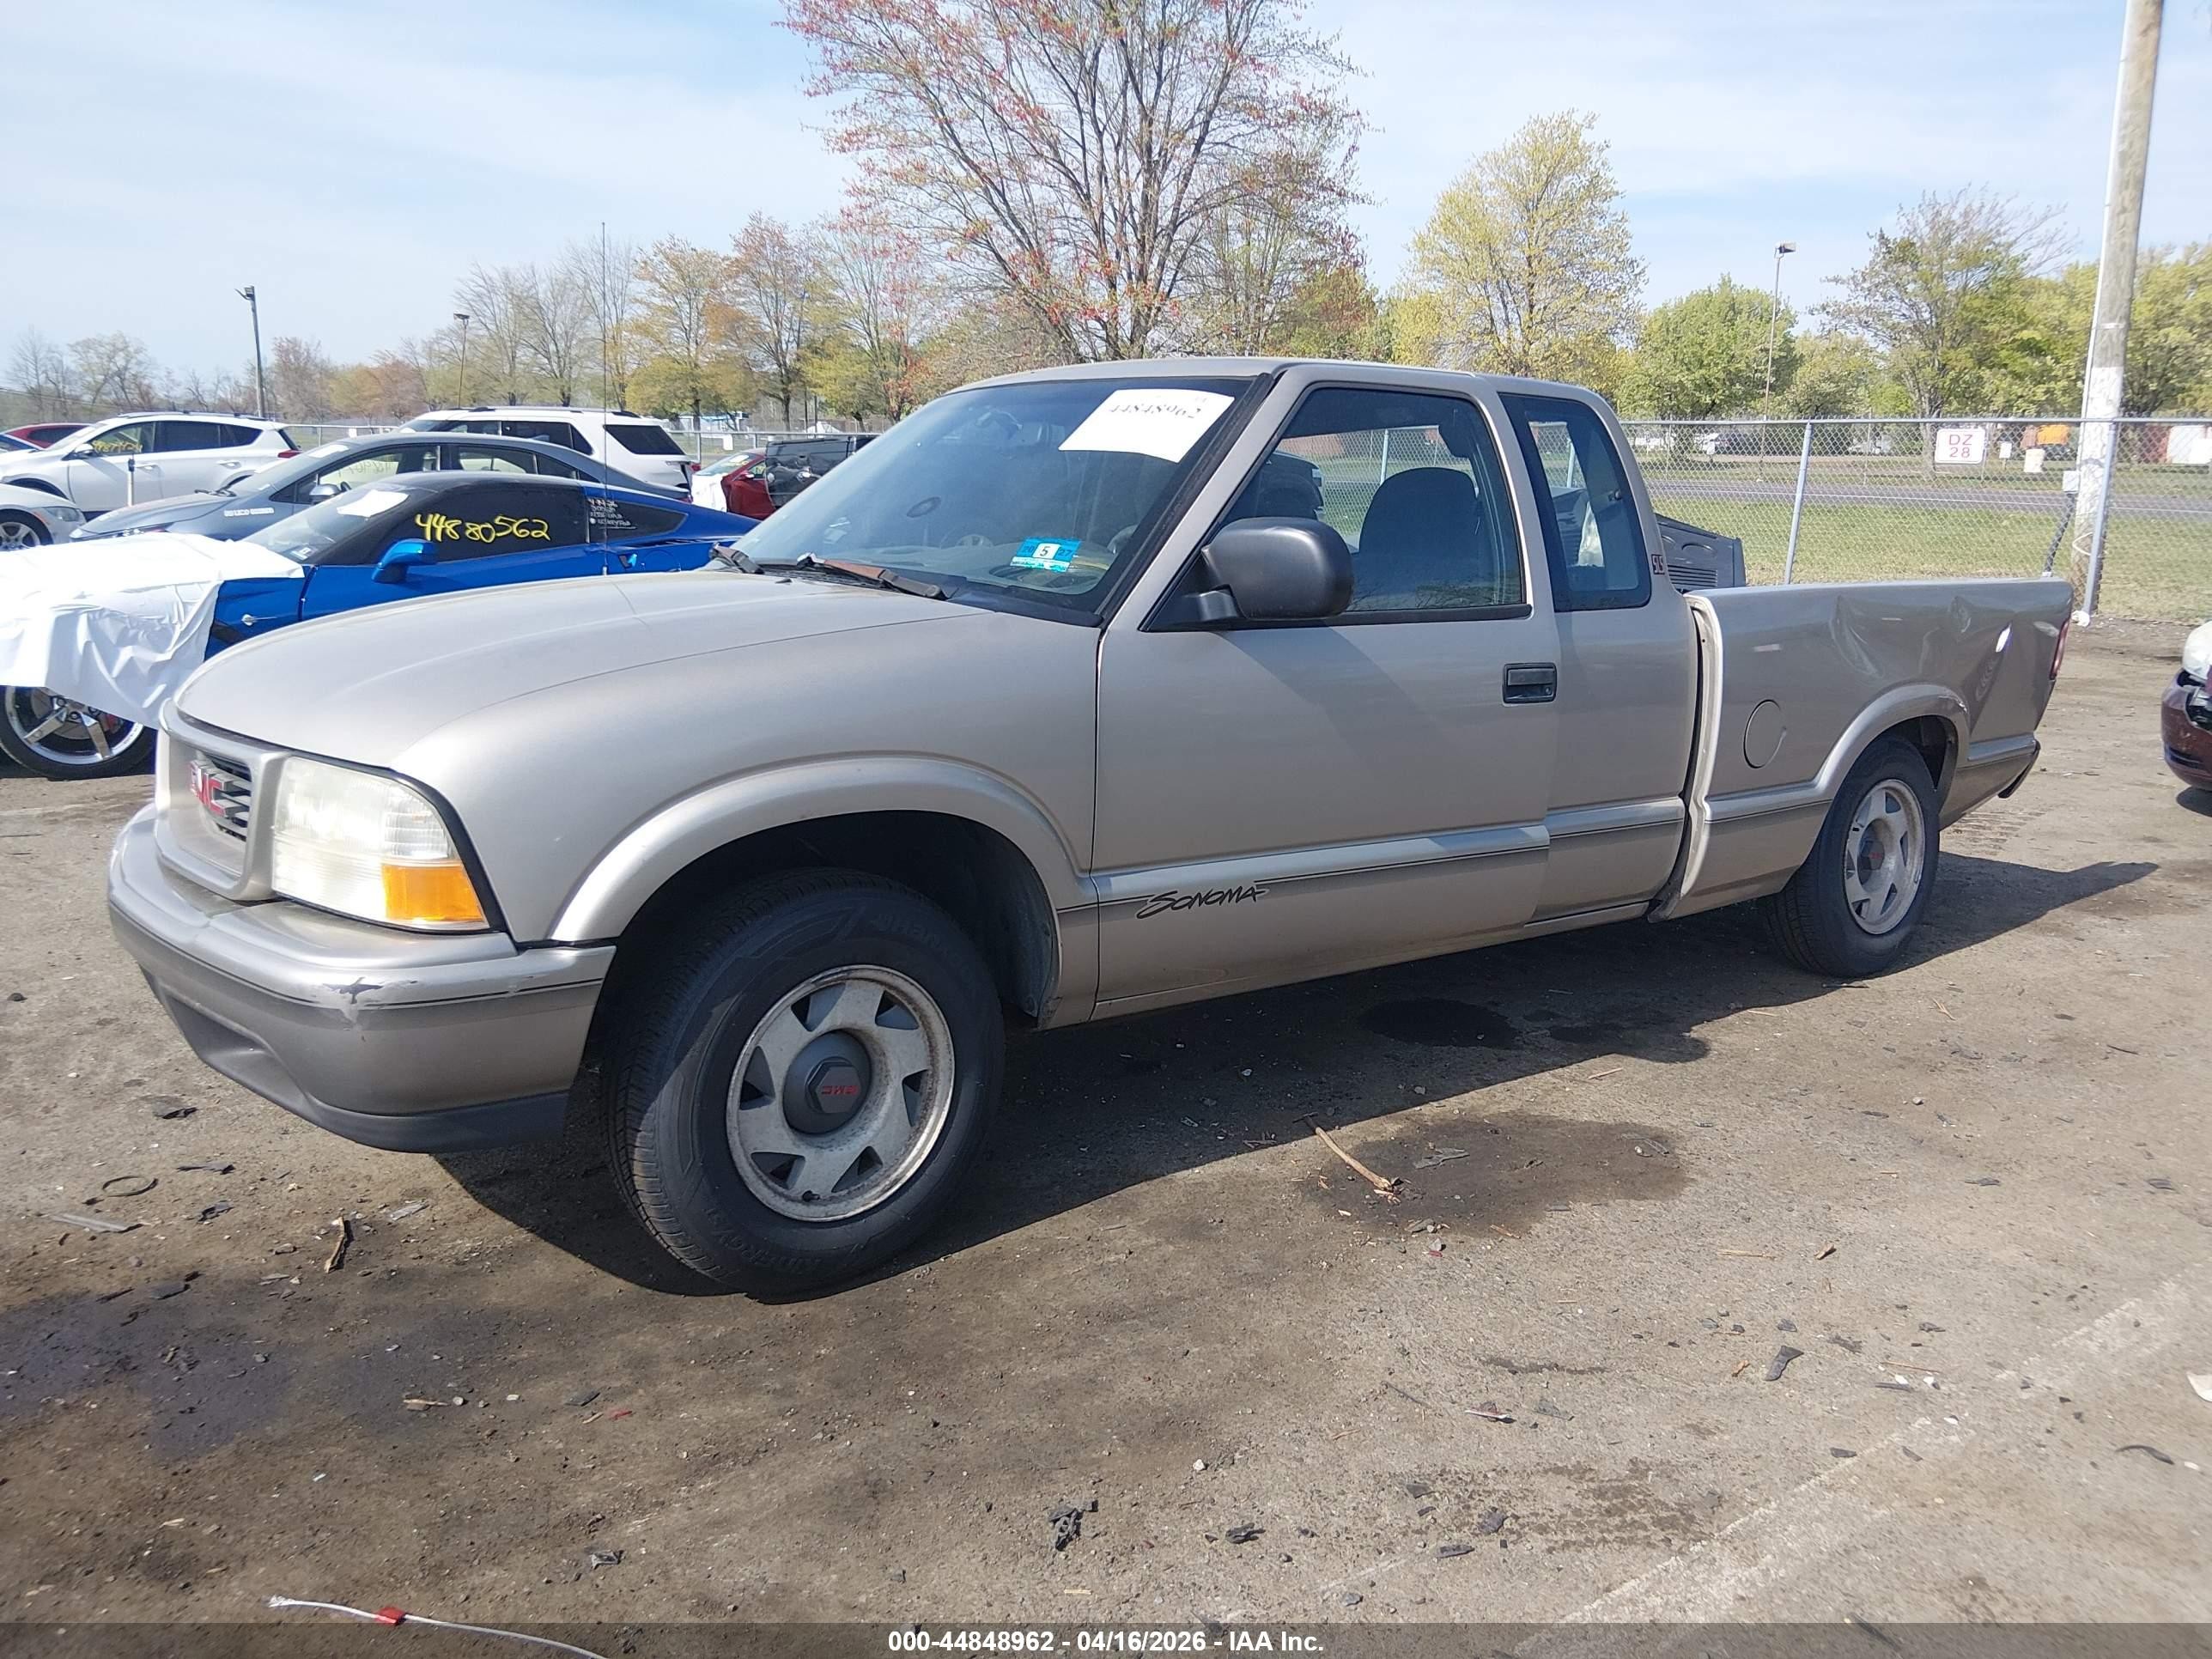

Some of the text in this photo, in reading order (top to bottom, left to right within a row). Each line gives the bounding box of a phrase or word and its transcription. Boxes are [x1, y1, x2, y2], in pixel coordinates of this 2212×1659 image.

[1948, 434, 1973, 446] DZ
[1949, 447, 1971, 459] 28
[415, 513, 550, 544] 44880562
[1039, 545, 1051, 556] 5
[1057, 549, 1073, 558] 27
